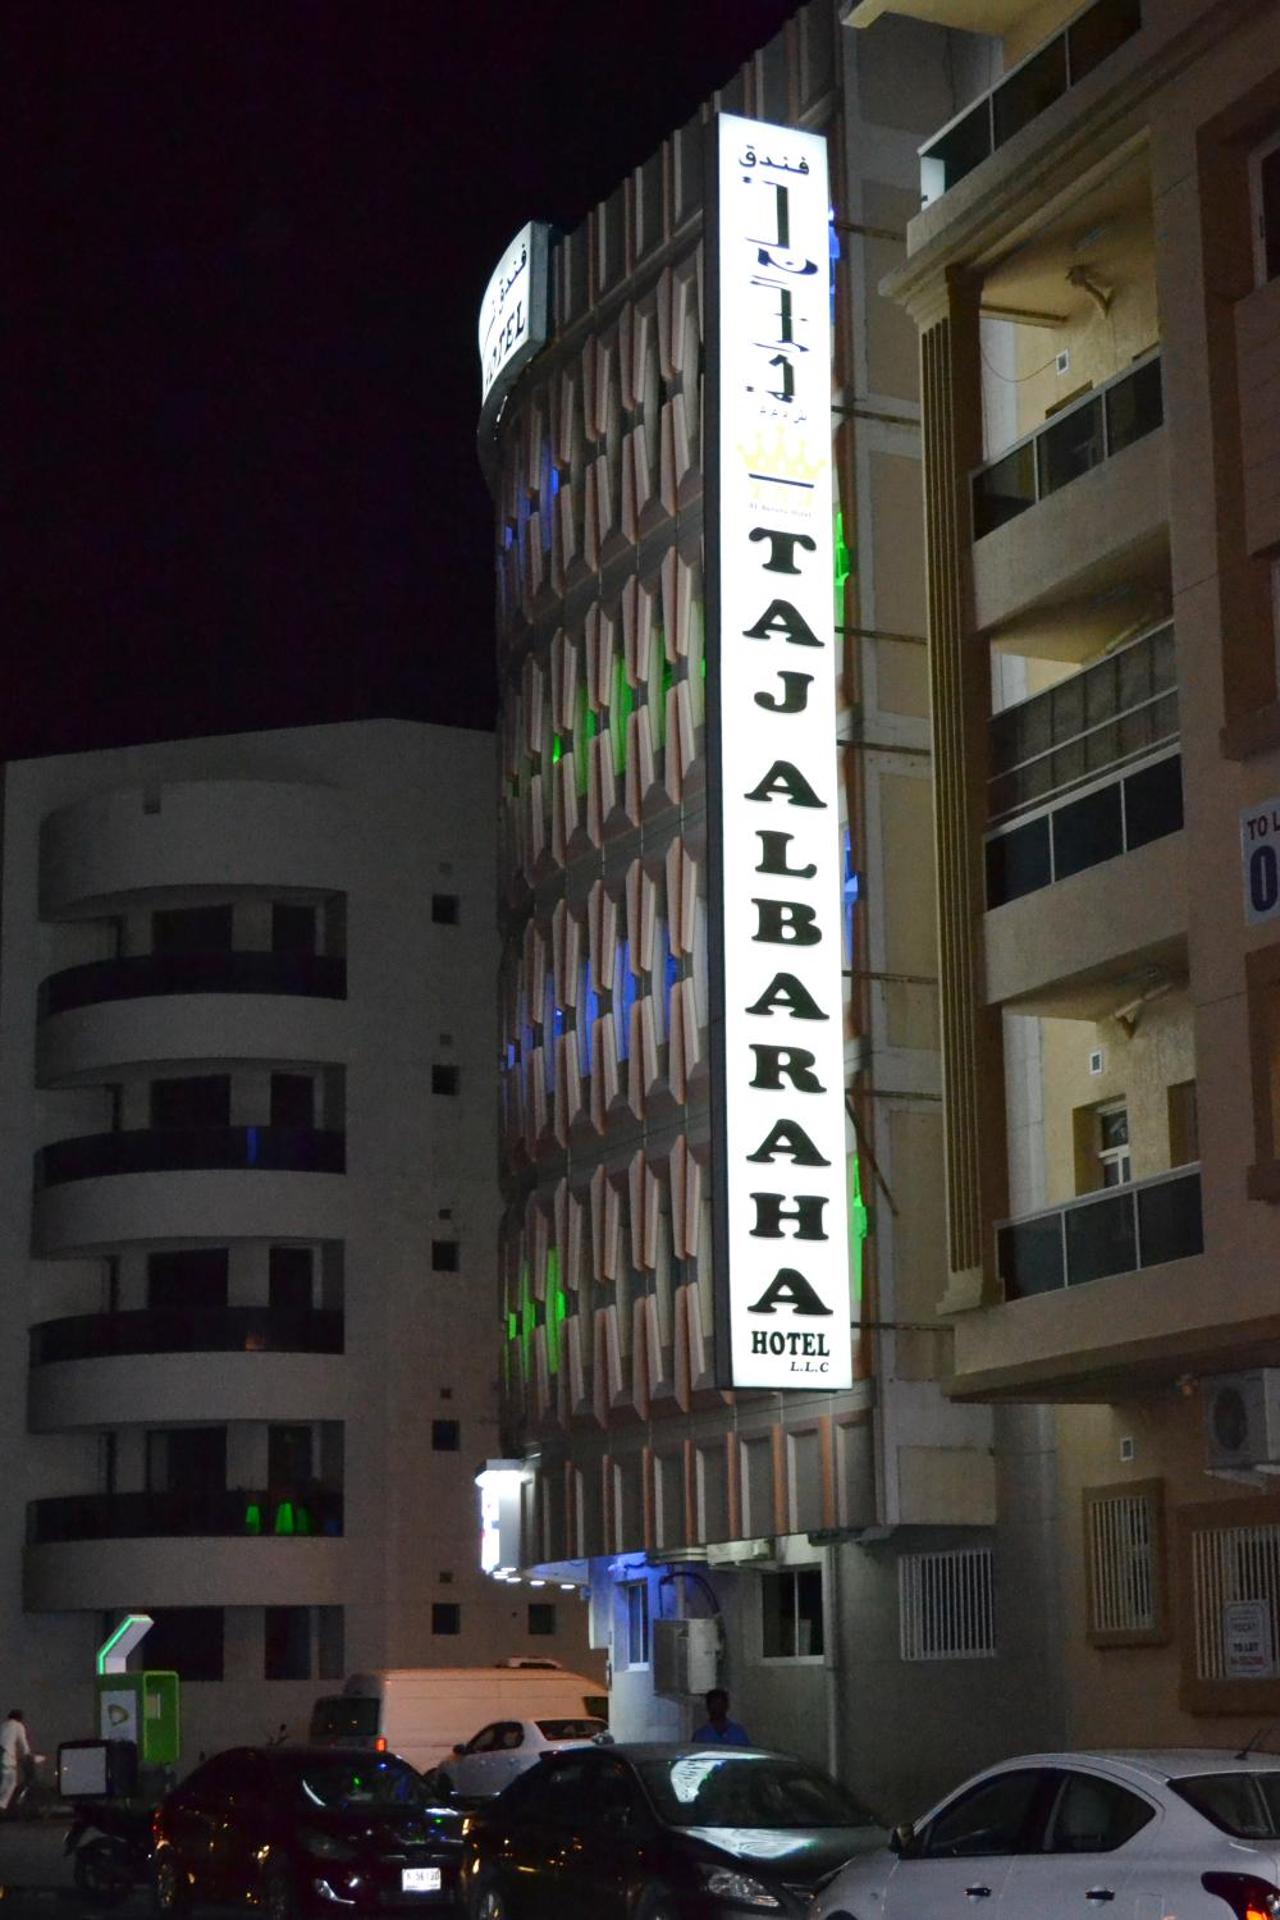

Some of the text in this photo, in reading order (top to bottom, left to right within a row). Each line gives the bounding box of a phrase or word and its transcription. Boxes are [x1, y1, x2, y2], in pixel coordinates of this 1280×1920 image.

[739, 145, 810, 175] فندق
[743, 527, 828, 714] TAJ
[1247, 815, 1268, 840] TO
[751, 1330, 831, 1357] HOTEL
[790, 1361, 830, 1373] L.L.C
